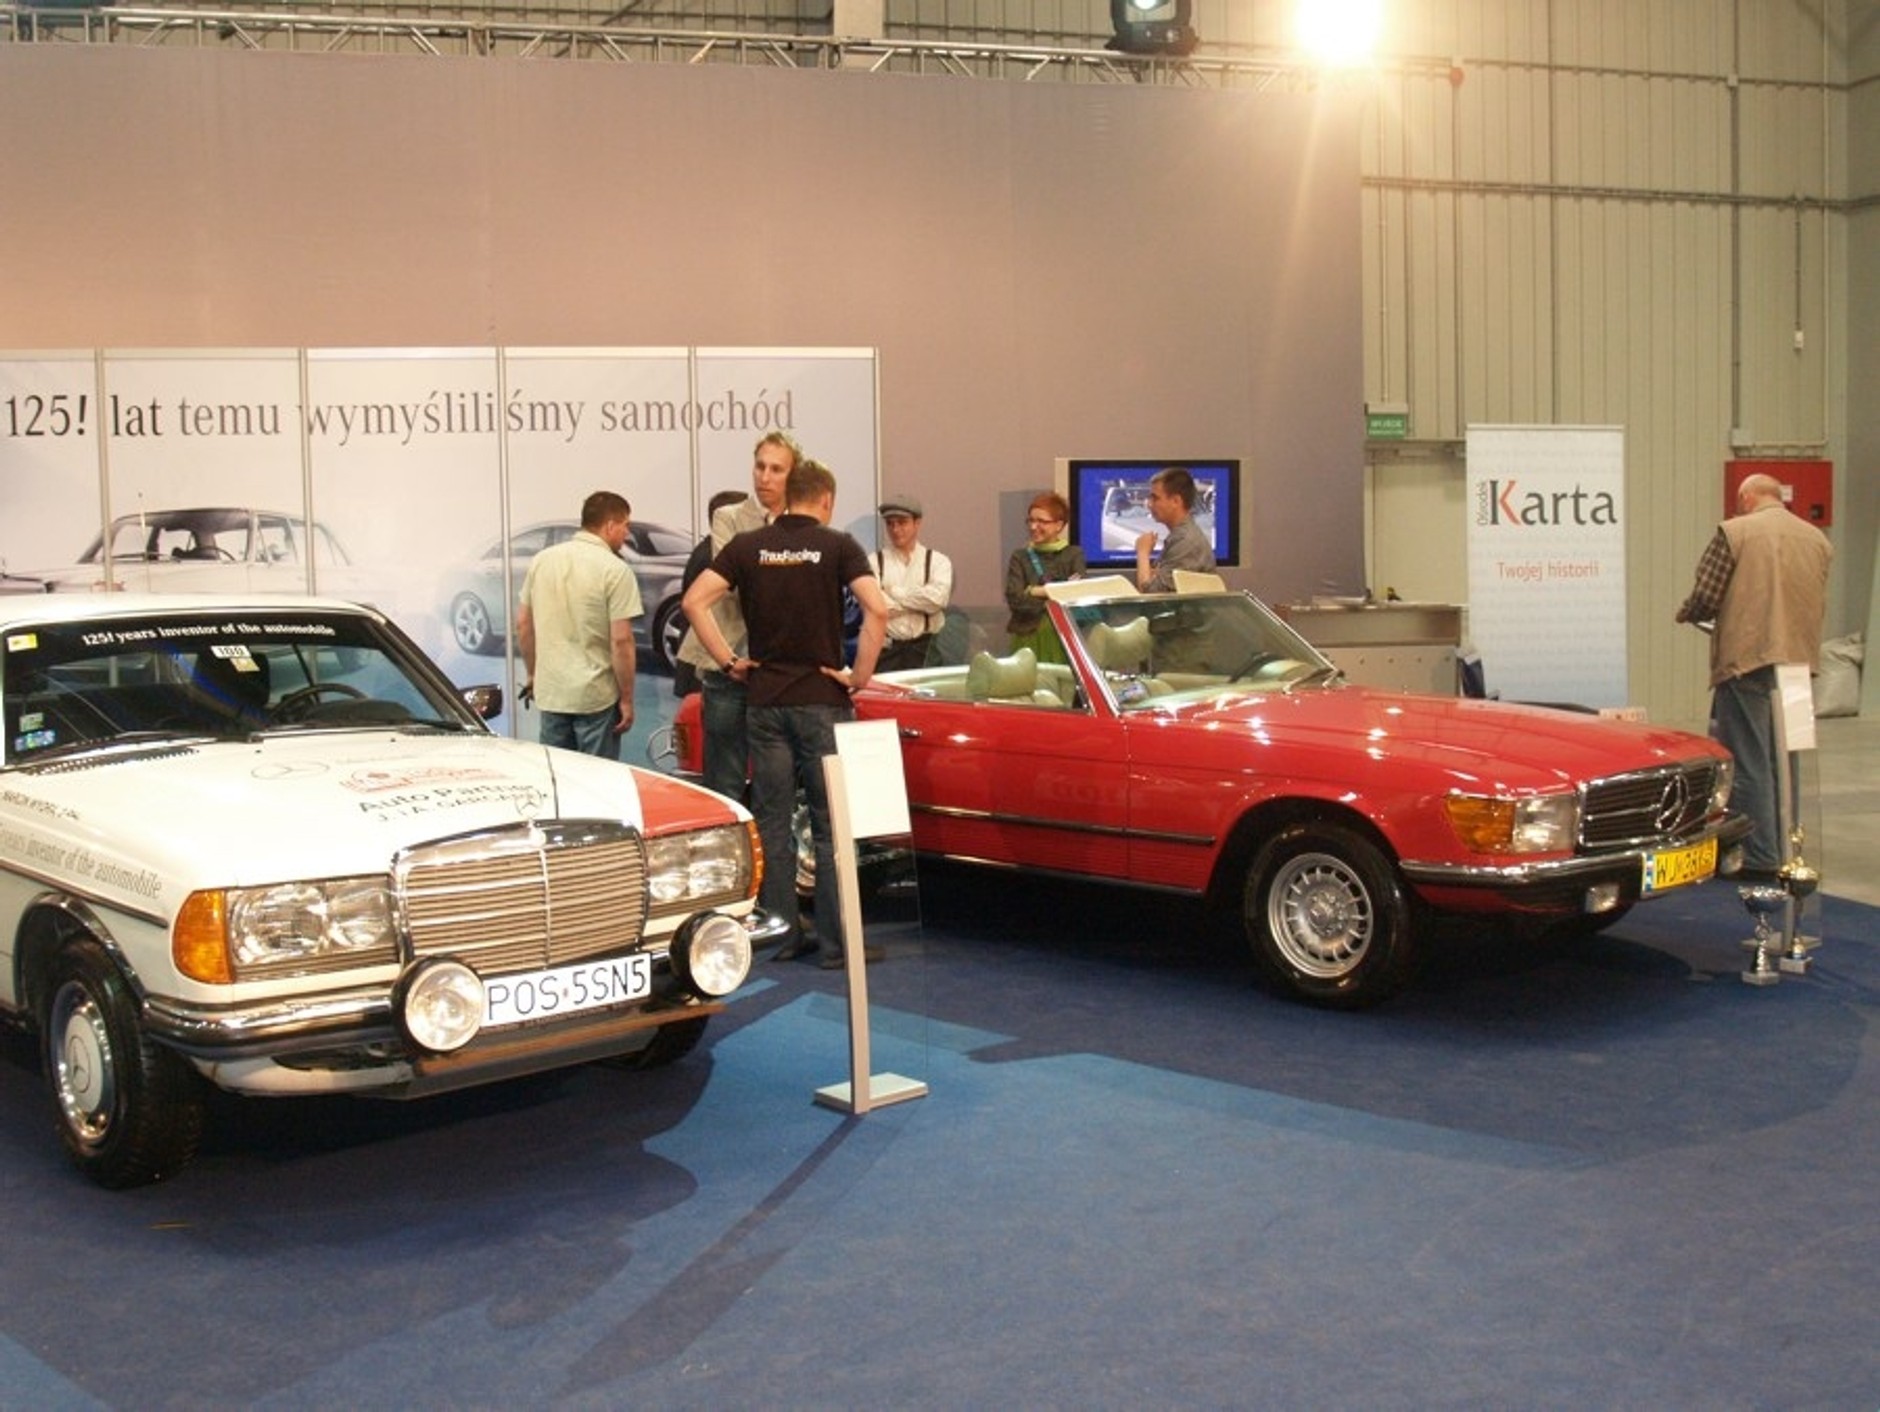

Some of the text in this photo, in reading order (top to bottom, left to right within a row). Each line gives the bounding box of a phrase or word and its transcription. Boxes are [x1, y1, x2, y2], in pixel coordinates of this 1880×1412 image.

[7, 387, 798, 446] 125! lat temu wymyśliliśmy samochód
[1489, 479, 1618, 526] Karta
[1496, 560, 1600, 582] Twojej historii
[115, 628, 158, 644] years
[158, 625, 219, 638] inventor
[221, 622, 237, 635] of
[237, 622, 262, 635] the
[263, 623, 336, 637] automobile
[488, 958, 647, 1021] POS 5SN5
